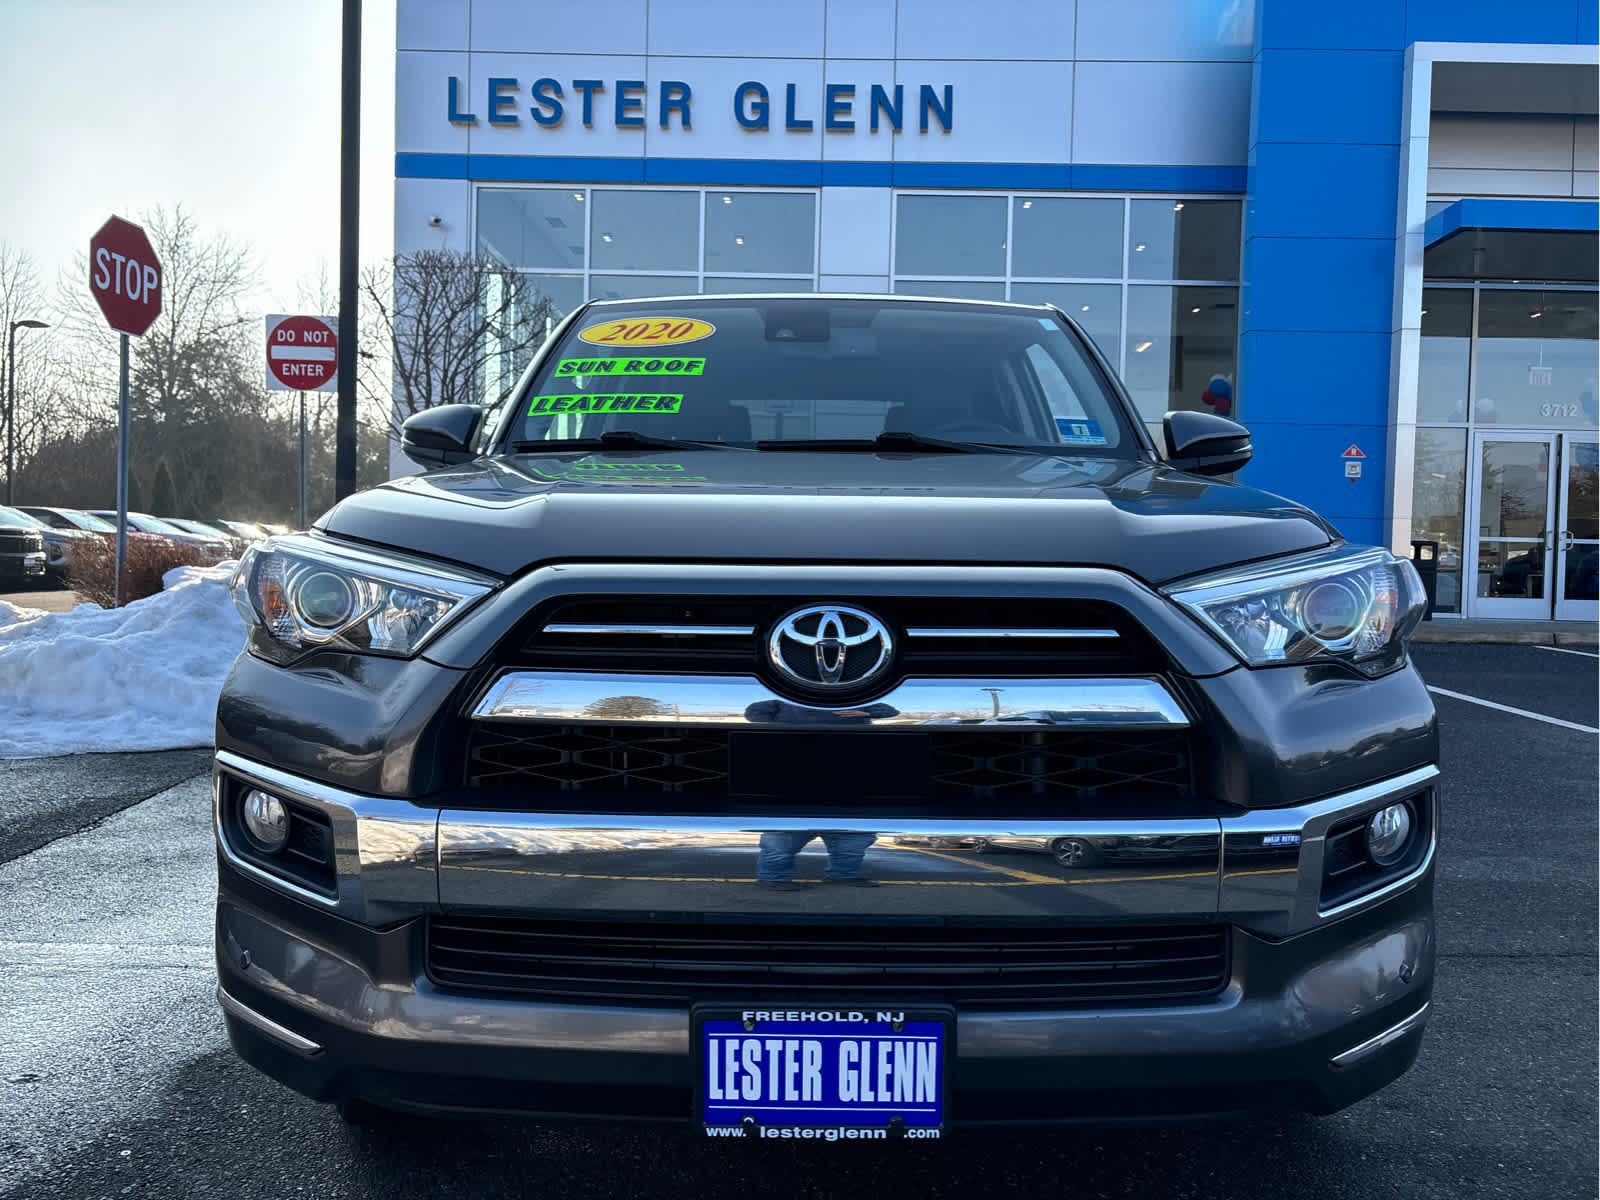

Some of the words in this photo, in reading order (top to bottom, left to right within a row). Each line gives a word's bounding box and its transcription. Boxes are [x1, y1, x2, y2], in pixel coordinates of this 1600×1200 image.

[448, 76, 692, 130] LESTER
[734, 81, 953, 132] GLENN
[95, 247, 159, 305] STOP
[277, 330, 296, 343] DO
[303, 330, 329, 344] NOT
[598, 322, 694, 341] 2020
[282, 363, 325, 377] ENTER
[559, 360, 617, 374] SUN
[623, 359, 704, 373] ROOF
[532, 395, 680, 413] LEATHER
[1541, 403, 1577, 417] 3712
[742, 1011, 870, 1024] FREEHOLD,
[876, 1011, 905, 1023] NJ
[709, 1039, 823, 1101] LESTER
[838, 1040, 937, 1103] GLENN
[705, 1127, 747, 1138] www.
[760, 1126, 887, 1141] lesterglenn
[903, 1127, 940, 1139] .com
